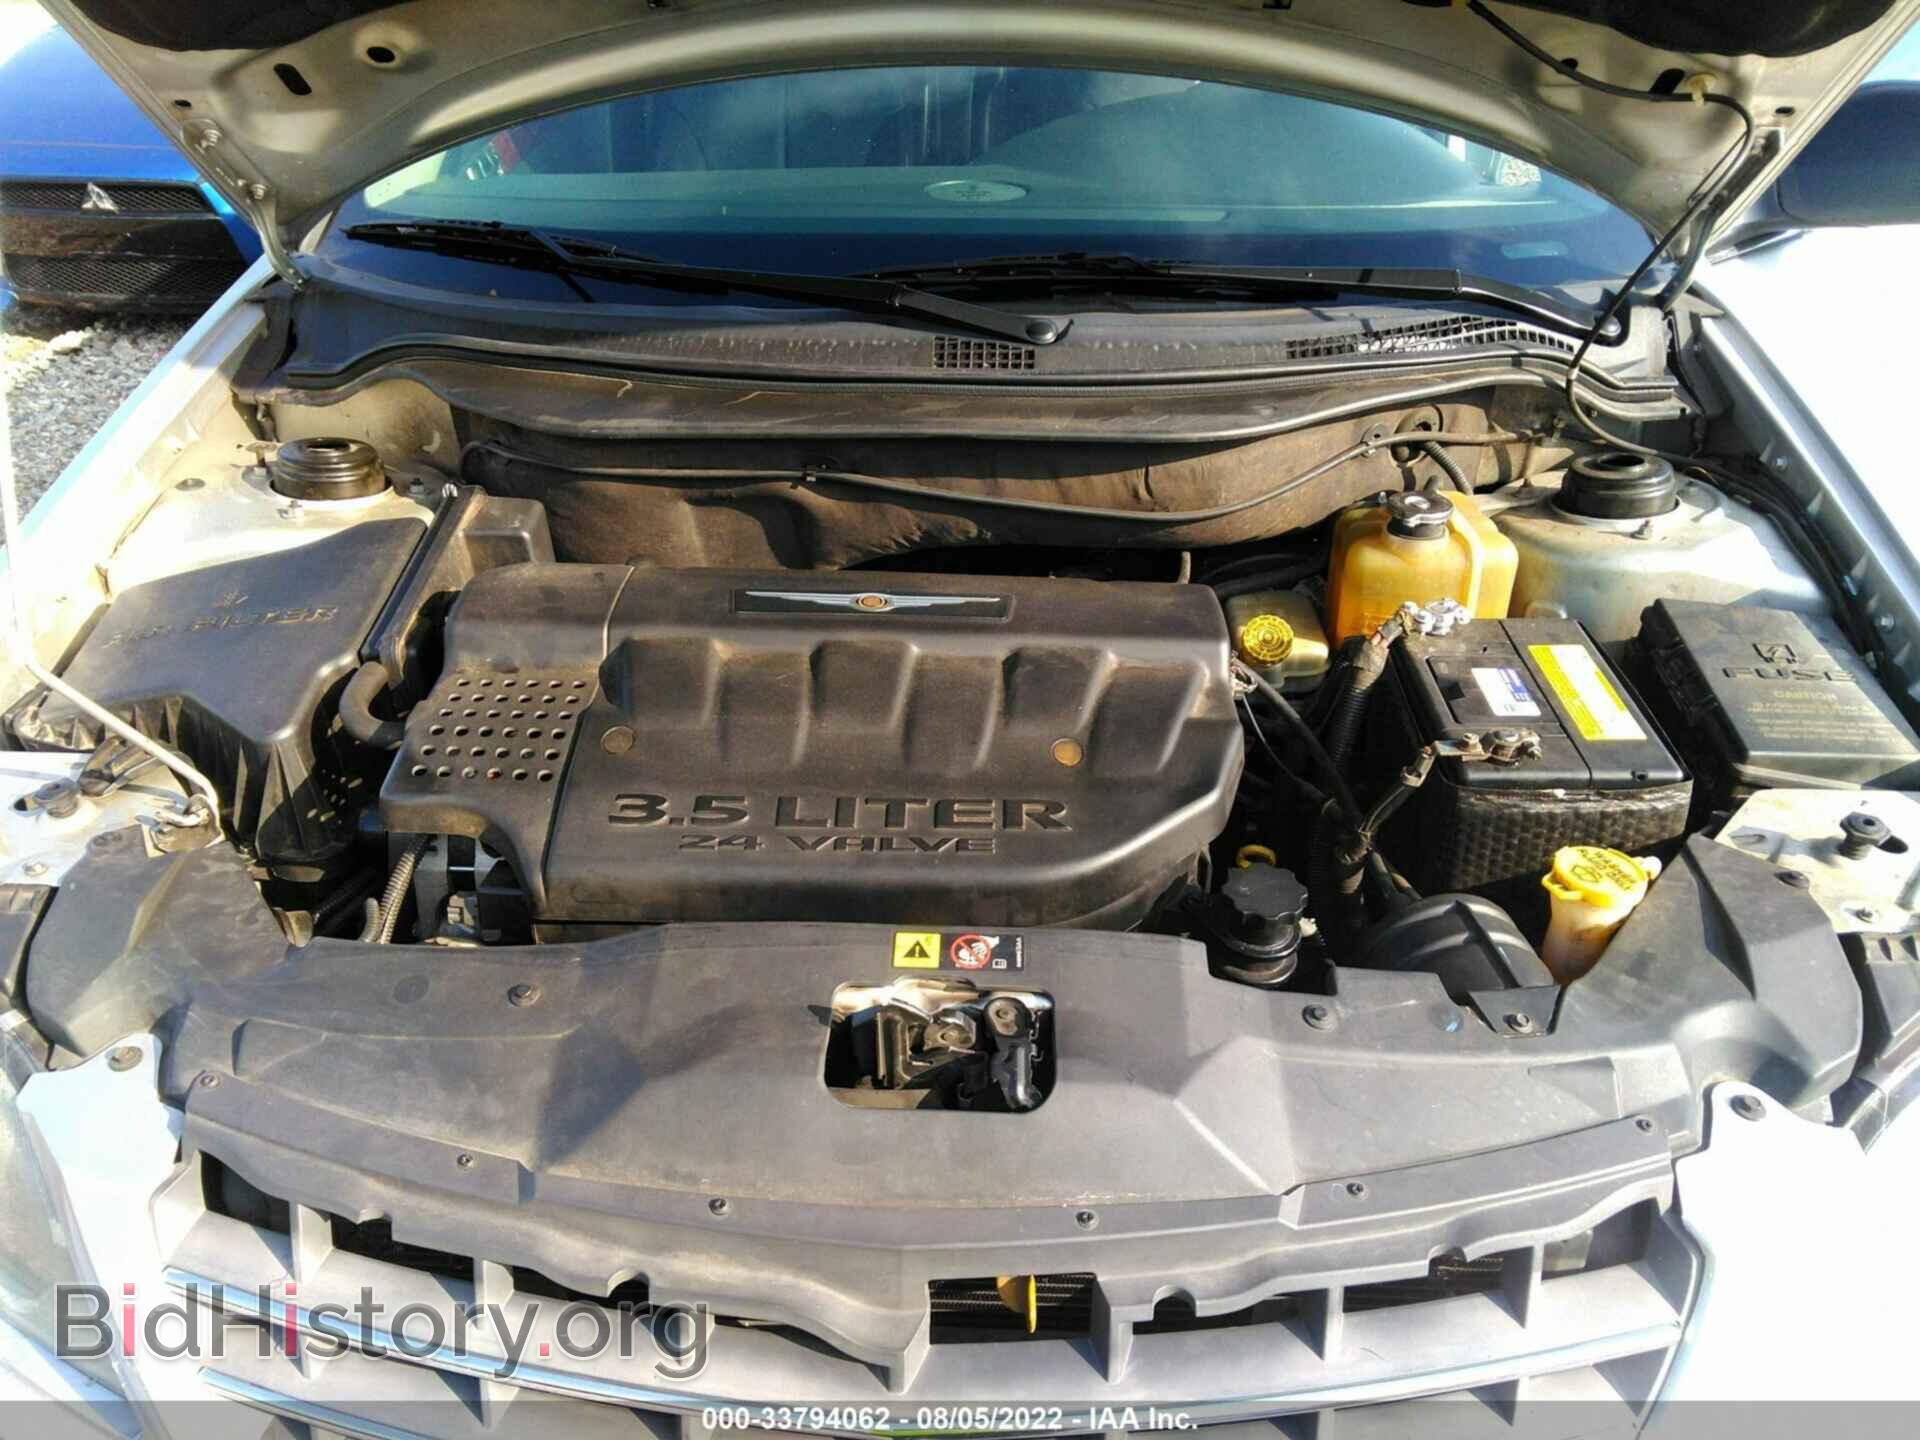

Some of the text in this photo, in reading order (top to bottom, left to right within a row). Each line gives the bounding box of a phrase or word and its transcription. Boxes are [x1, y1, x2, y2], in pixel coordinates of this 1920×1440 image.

[1721, 667, 1856, 682] FUSE
[607, 793, 1074, 831] 3.5 LITER
[678, 833, 997, 854] 24 VALVE
